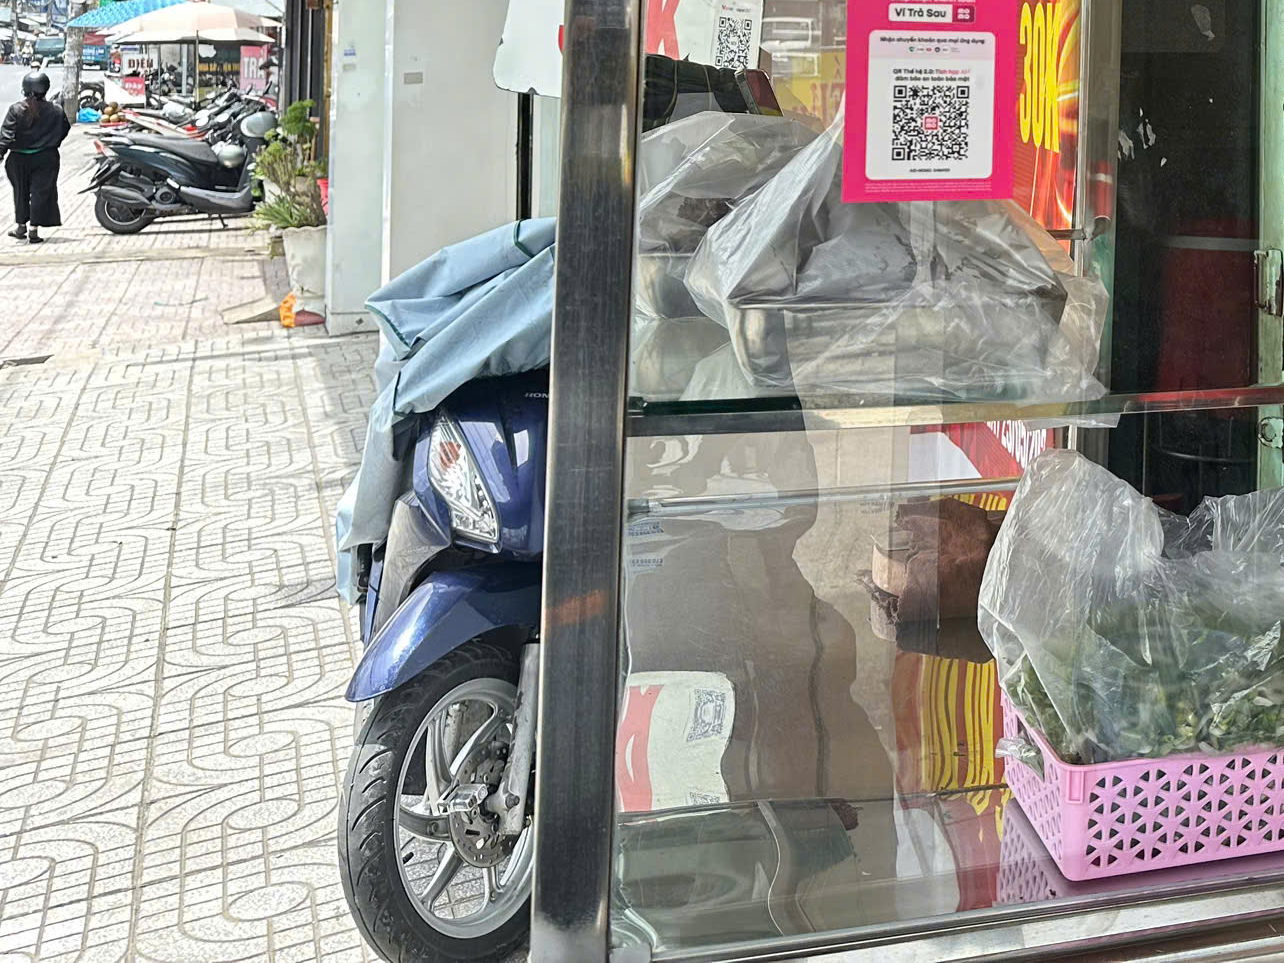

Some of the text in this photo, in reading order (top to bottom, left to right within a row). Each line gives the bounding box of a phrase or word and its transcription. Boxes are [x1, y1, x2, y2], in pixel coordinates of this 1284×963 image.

[908, 8, 924, 18] Trả
[926, 9, 946, 18] Sau
[1020, 2, 1062, 154] 30K
